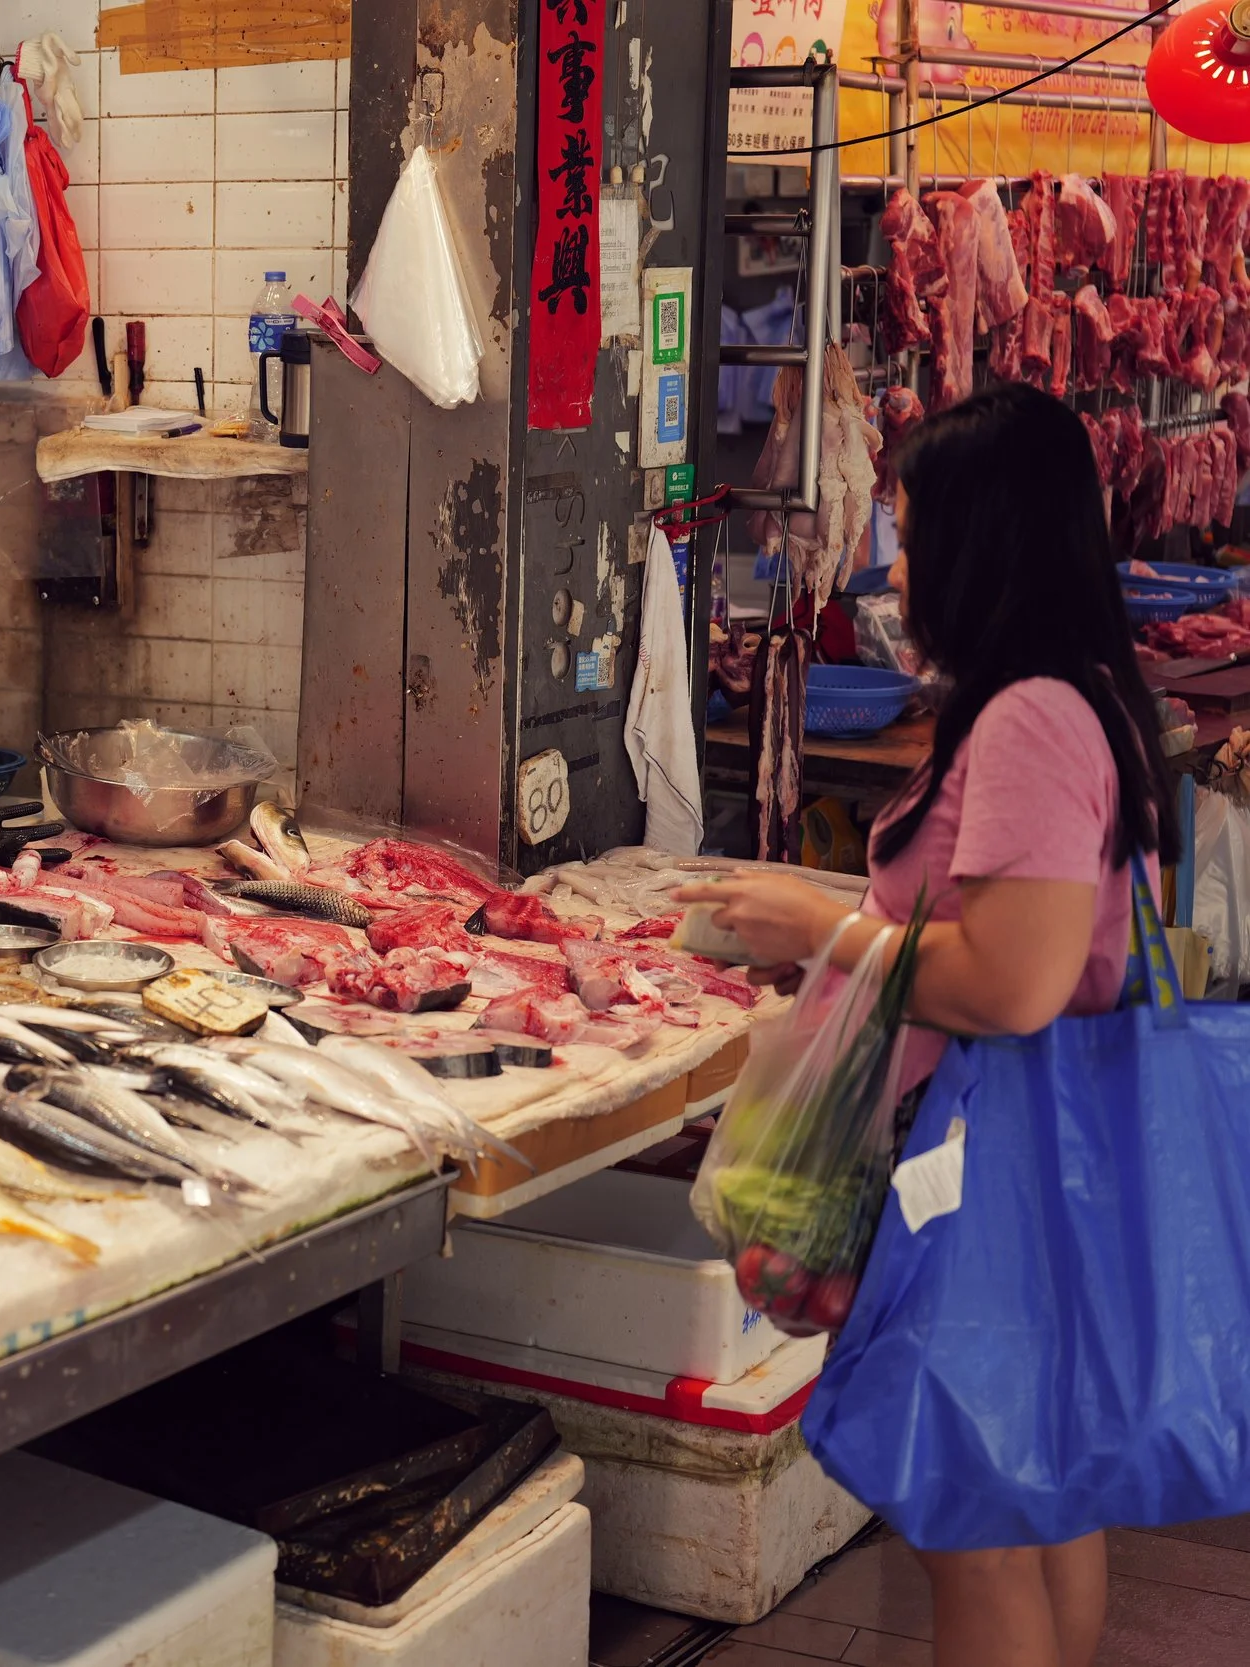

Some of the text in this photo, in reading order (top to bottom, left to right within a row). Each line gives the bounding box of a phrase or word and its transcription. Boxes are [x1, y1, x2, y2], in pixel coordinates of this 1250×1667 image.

[1021, 105, 1065, 140] Healthy
[537, 0, 597, 315] 事業興
[528, 778, 563, 834] 80
